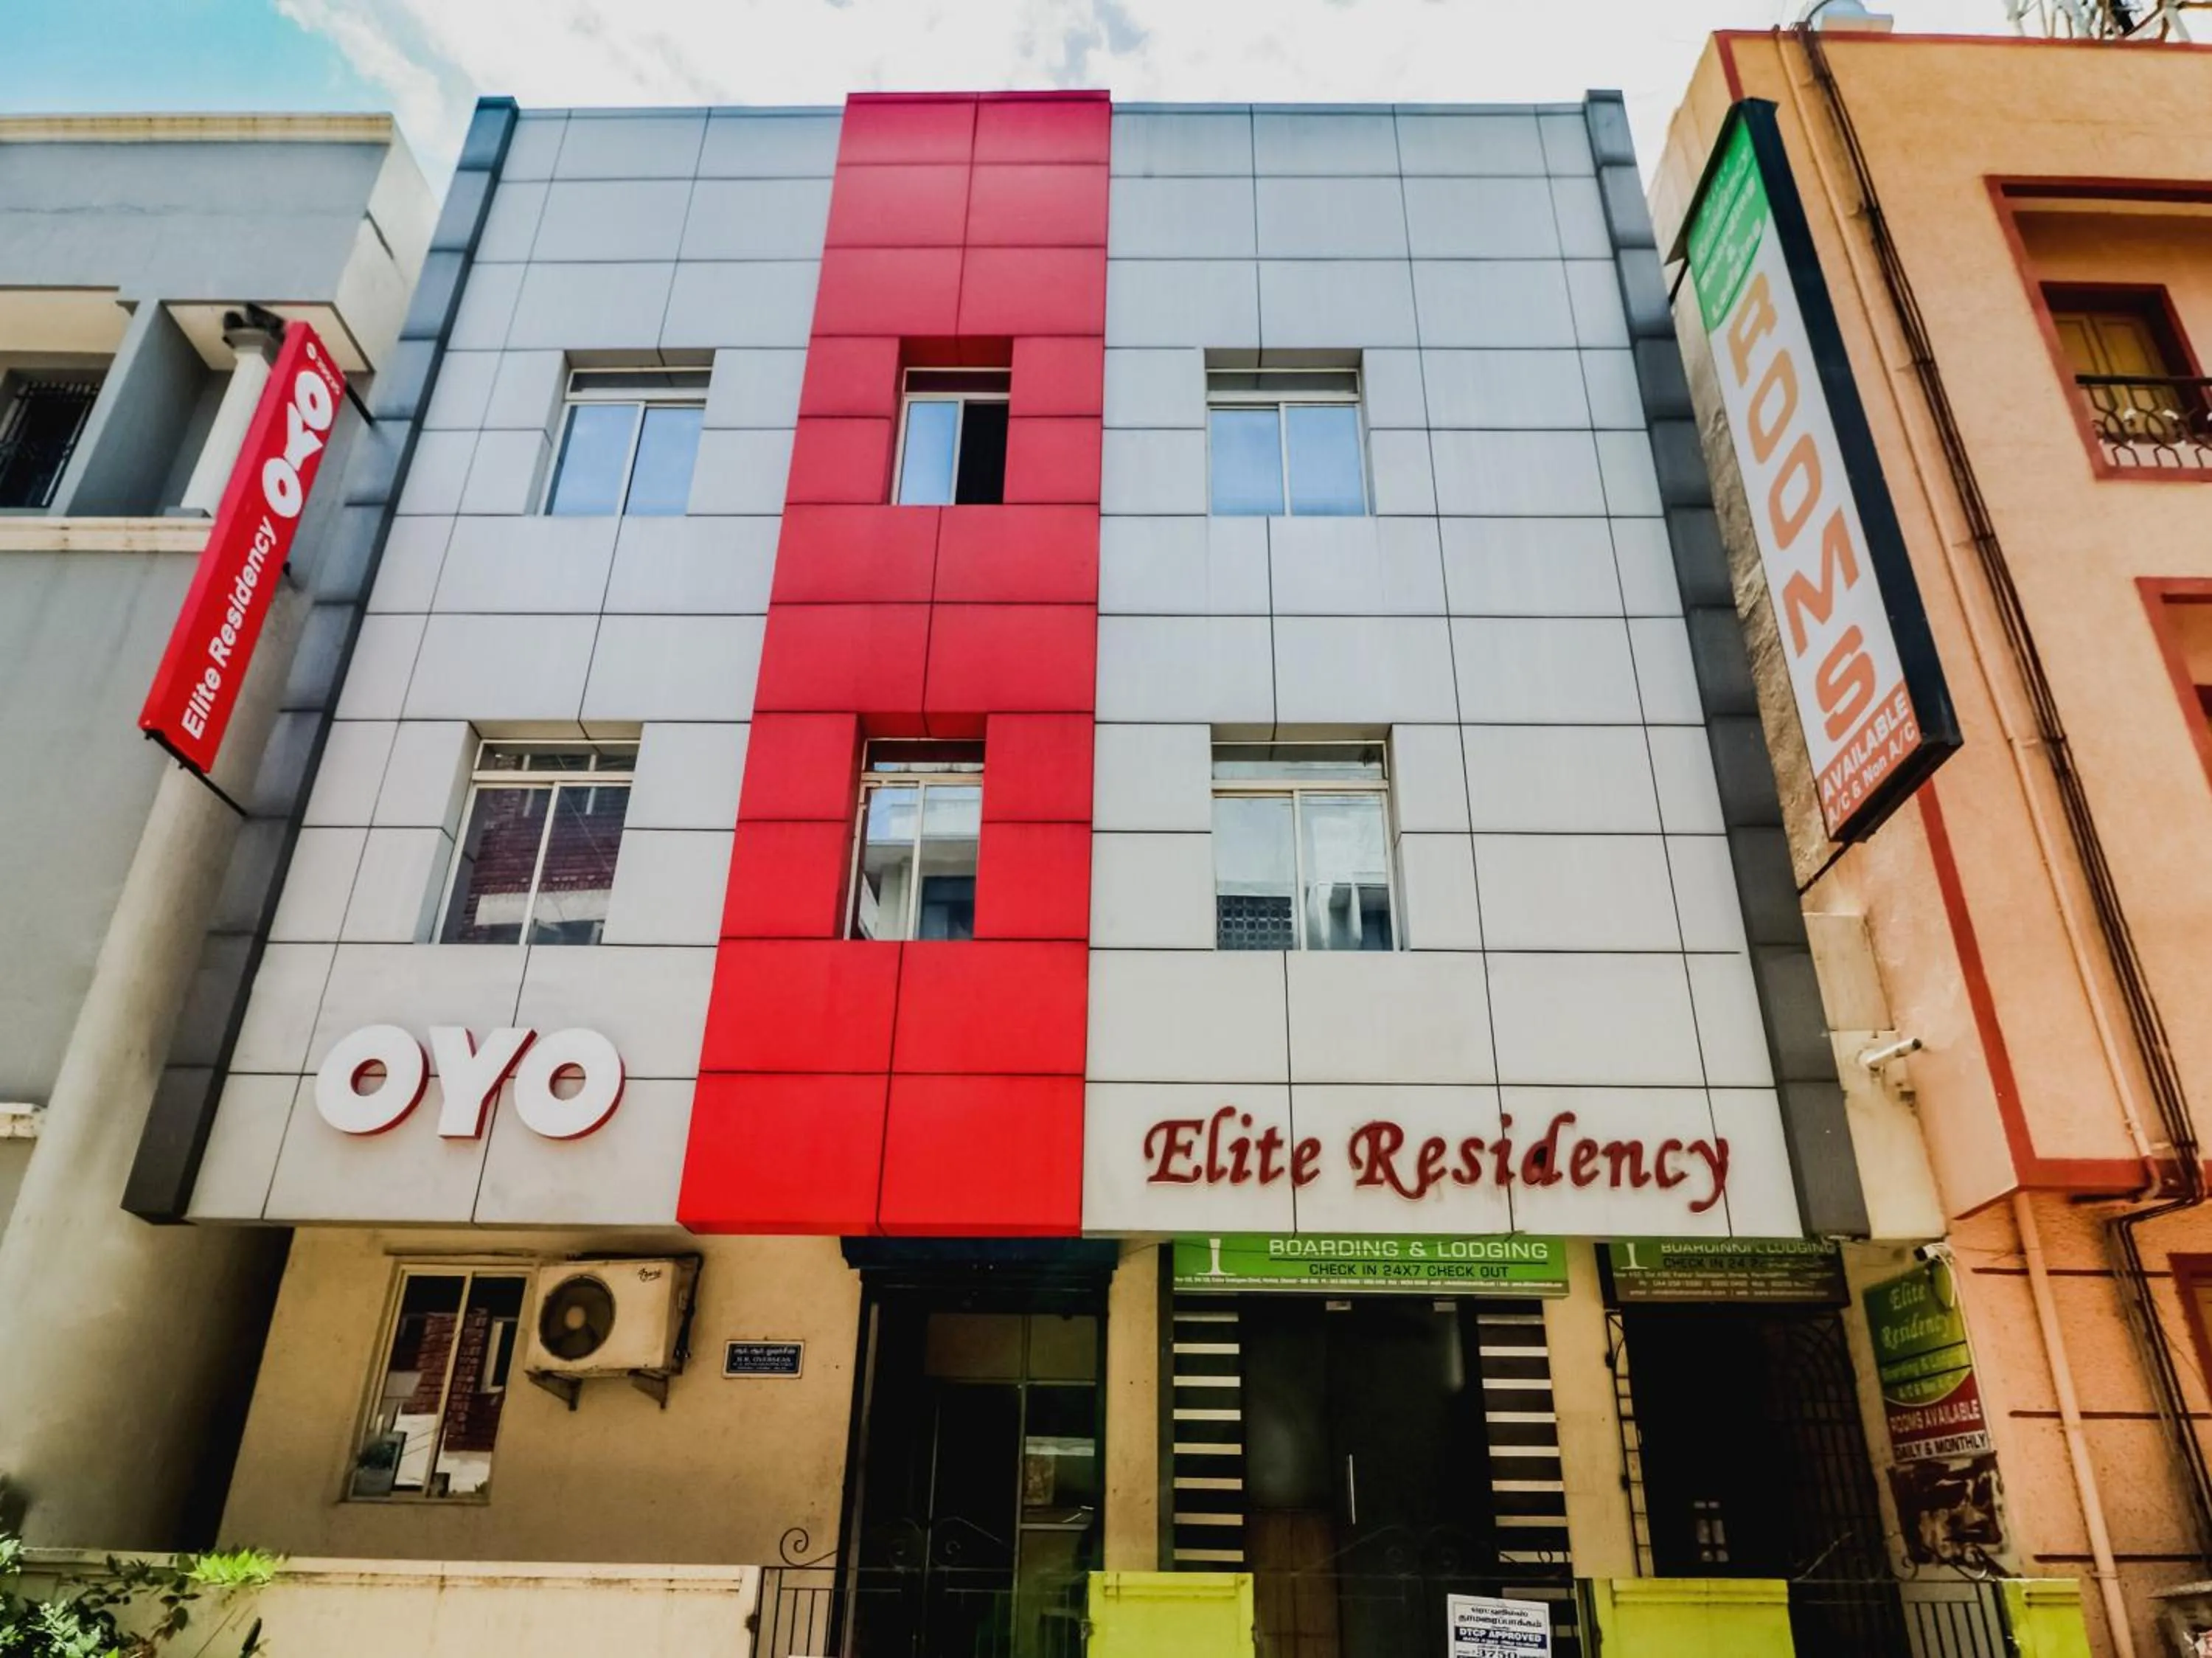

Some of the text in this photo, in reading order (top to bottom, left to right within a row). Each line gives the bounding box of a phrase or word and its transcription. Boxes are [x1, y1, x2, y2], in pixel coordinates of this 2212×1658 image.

[262, 370, 334, 518] OYO
[1727, 272, 1876, 743] ROOMS
[181, 516, 277, 740] Elite Residency
[1823, 692, 1909, 805] AVAILABLE
[1862, 755, 1888, 788] Non
[1889, 721, 1916, 760] A/C
[315, 1024, 626, 1140] OYO
[1144, 1106, 1729, 1213] Elite Residency
[1269, 1240, 1548, 1259] BOARDING & LODGING
[1309, 1263, 1510, 1278] CHECK IN 24X7 CHECK OUT
[1889, 1283, 1926, 1311] Elite
[1882, 1313, 1949, 1350] Residency
[1924, 1399, 1981, 1430] AVAILABLE
[1934, 1433, 1987, 1454] MONTHLY
[1489, 1630, 1543, 1643] APPROVED
